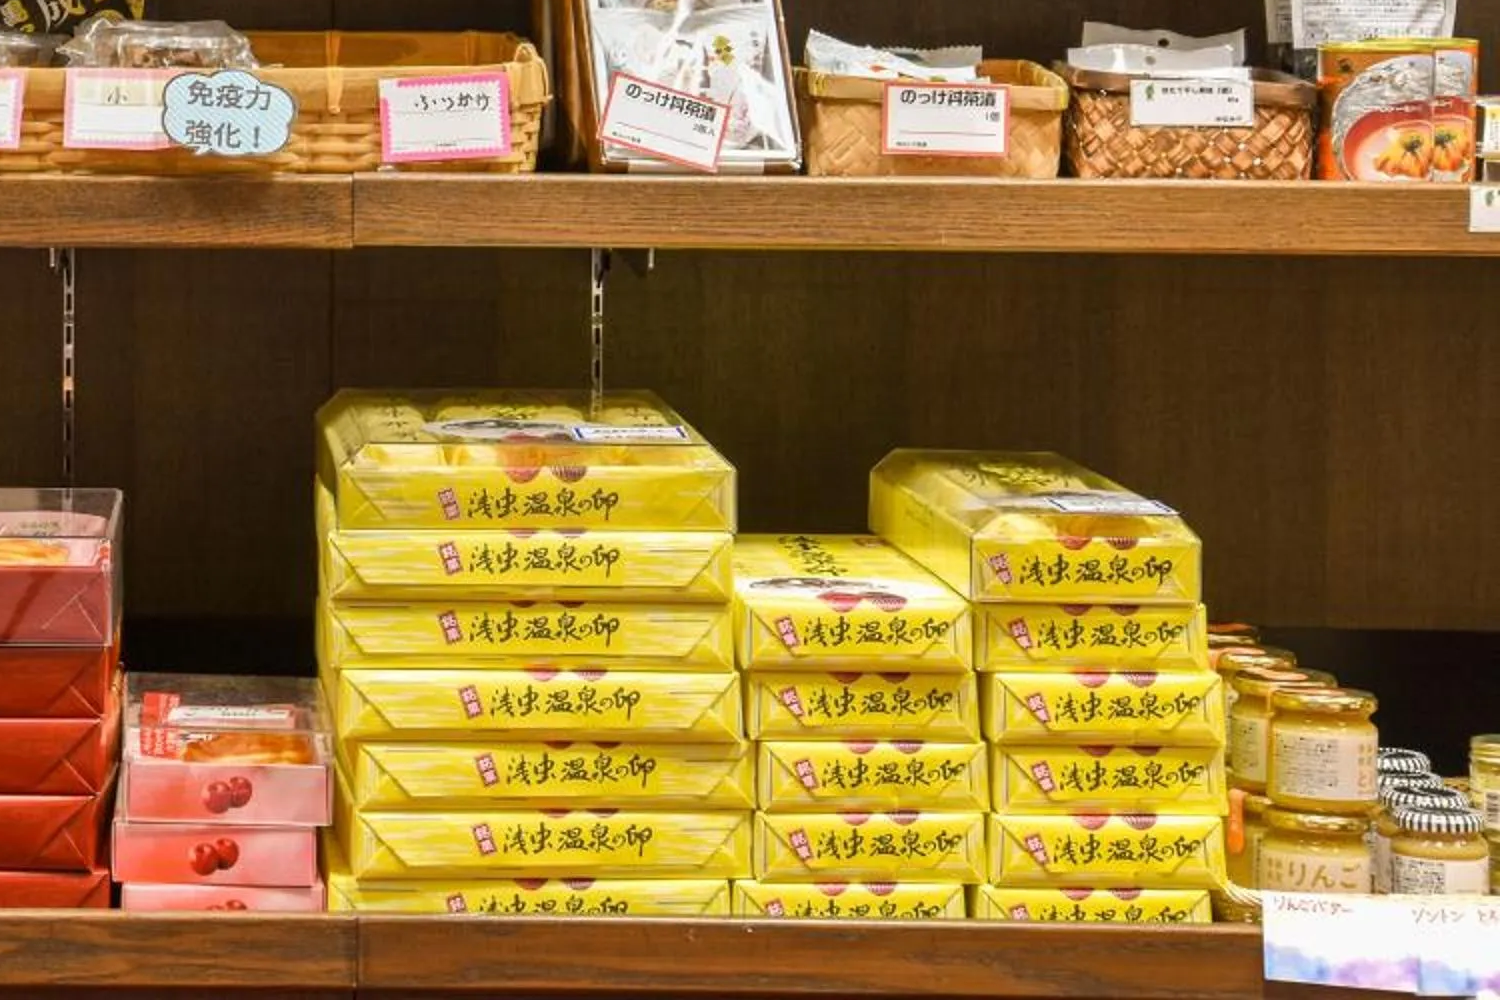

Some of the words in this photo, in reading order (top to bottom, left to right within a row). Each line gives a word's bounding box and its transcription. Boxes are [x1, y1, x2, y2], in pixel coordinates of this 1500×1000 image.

[187, 80, 272, 112] 免疫力
[900, 89, 997, 108] のっけ丼茶漬
[1290, 863, 1361, 889] りんご
